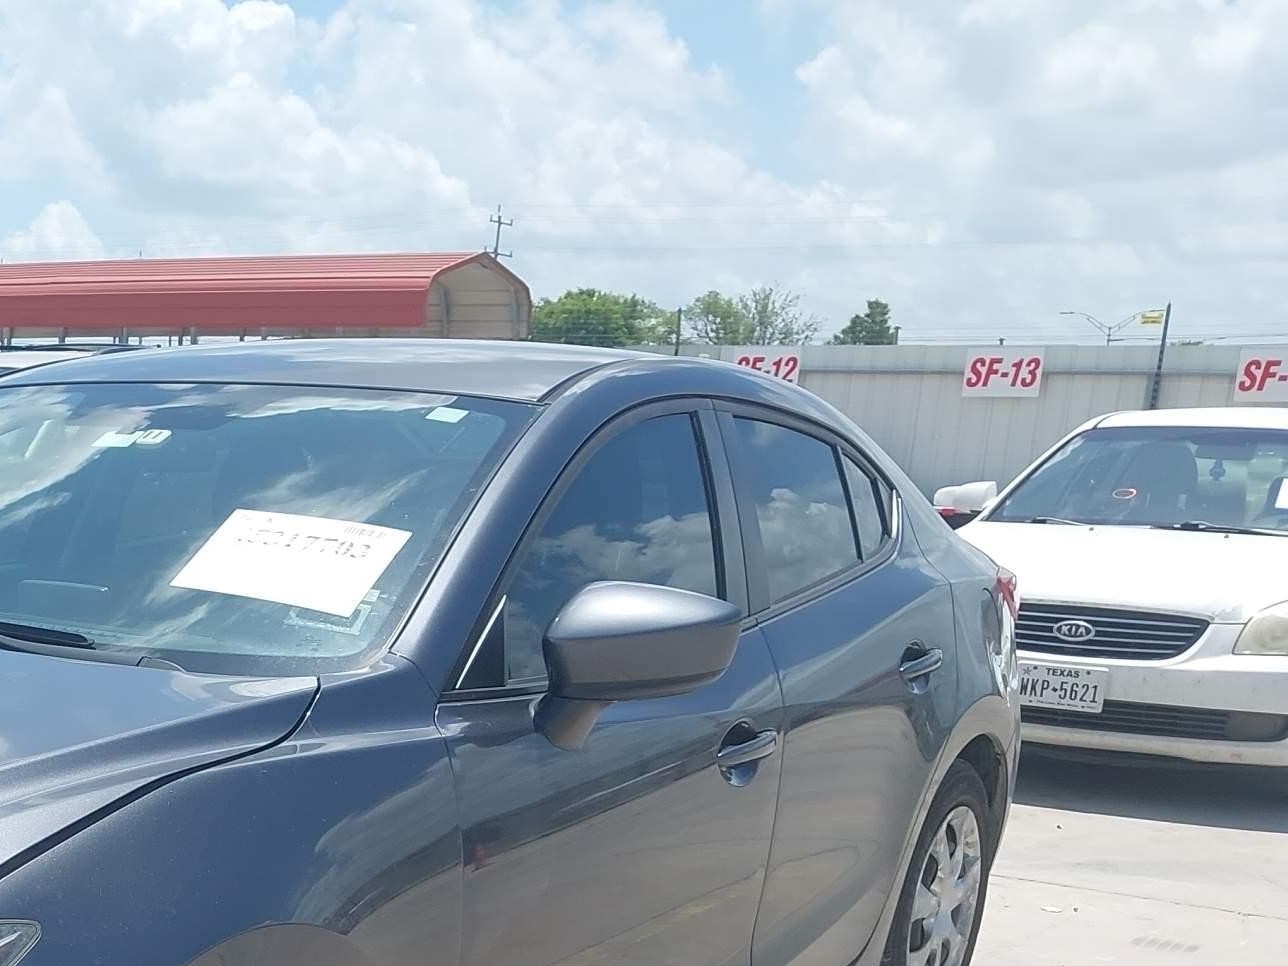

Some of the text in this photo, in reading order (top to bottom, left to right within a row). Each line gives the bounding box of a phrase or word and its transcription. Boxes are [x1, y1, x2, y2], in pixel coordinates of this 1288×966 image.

[965, 357, 1042, 388] SF-13
[1060, 625, 1087, 637] KIA
[1045, 667, 1081, 679] TEXAS
